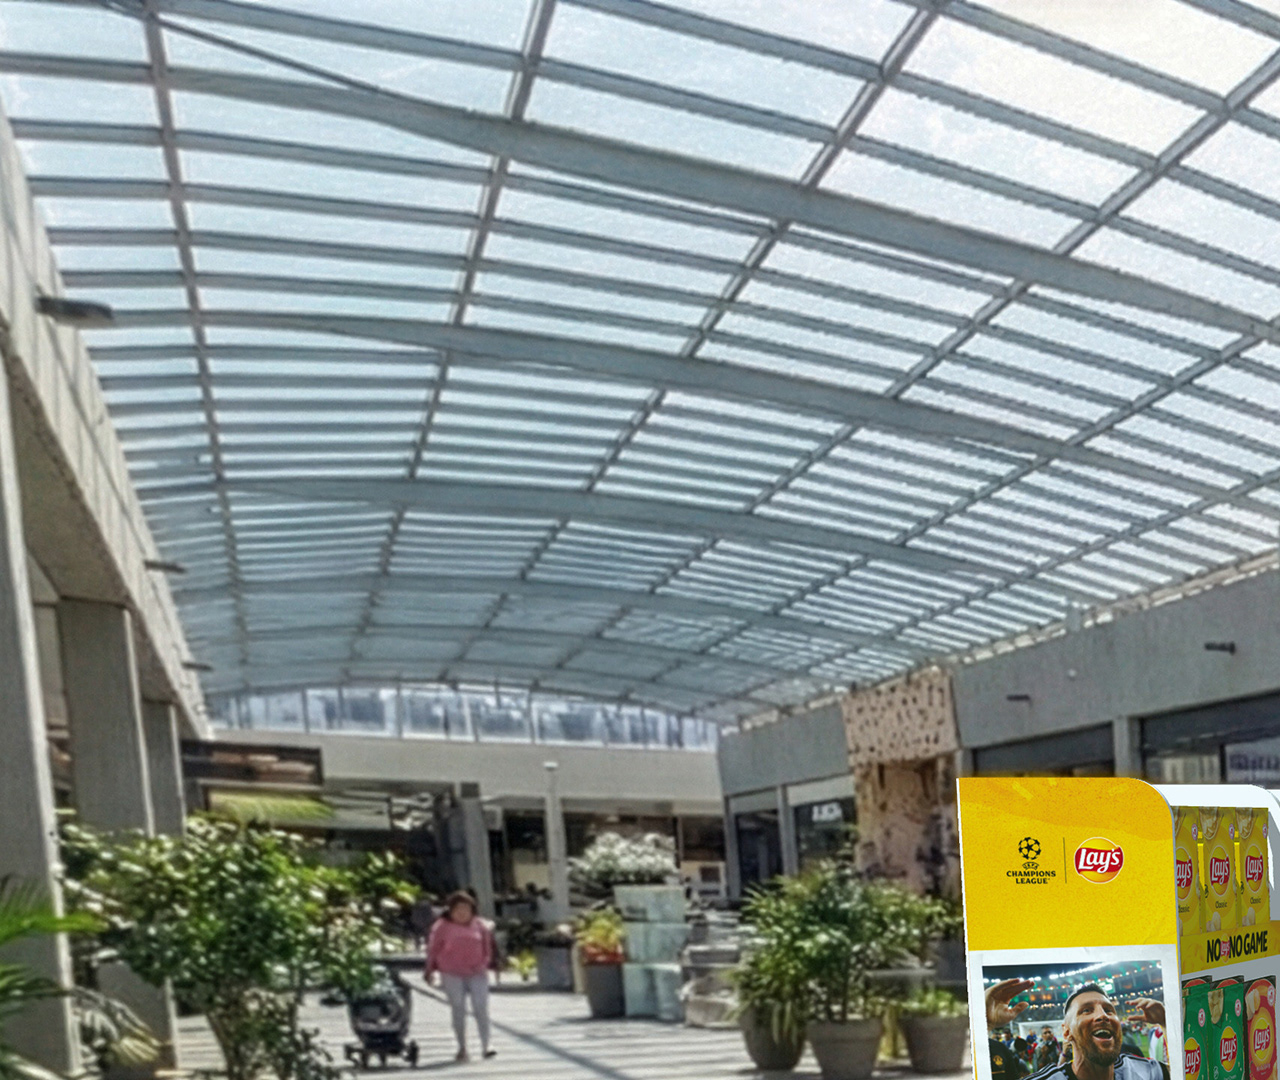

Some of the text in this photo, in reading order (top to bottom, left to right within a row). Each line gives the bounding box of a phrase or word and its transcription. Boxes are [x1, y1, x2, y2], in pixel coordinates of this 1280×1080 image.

[1006, 870, 1056, 878] CHAMPIONS
[1078, 849, 1121, 874] Lay's
[1206, 938, 1221, 963] NO
[1229, 935, 1243, 958] NO
[1243, 930, 1268, 954] GAME
